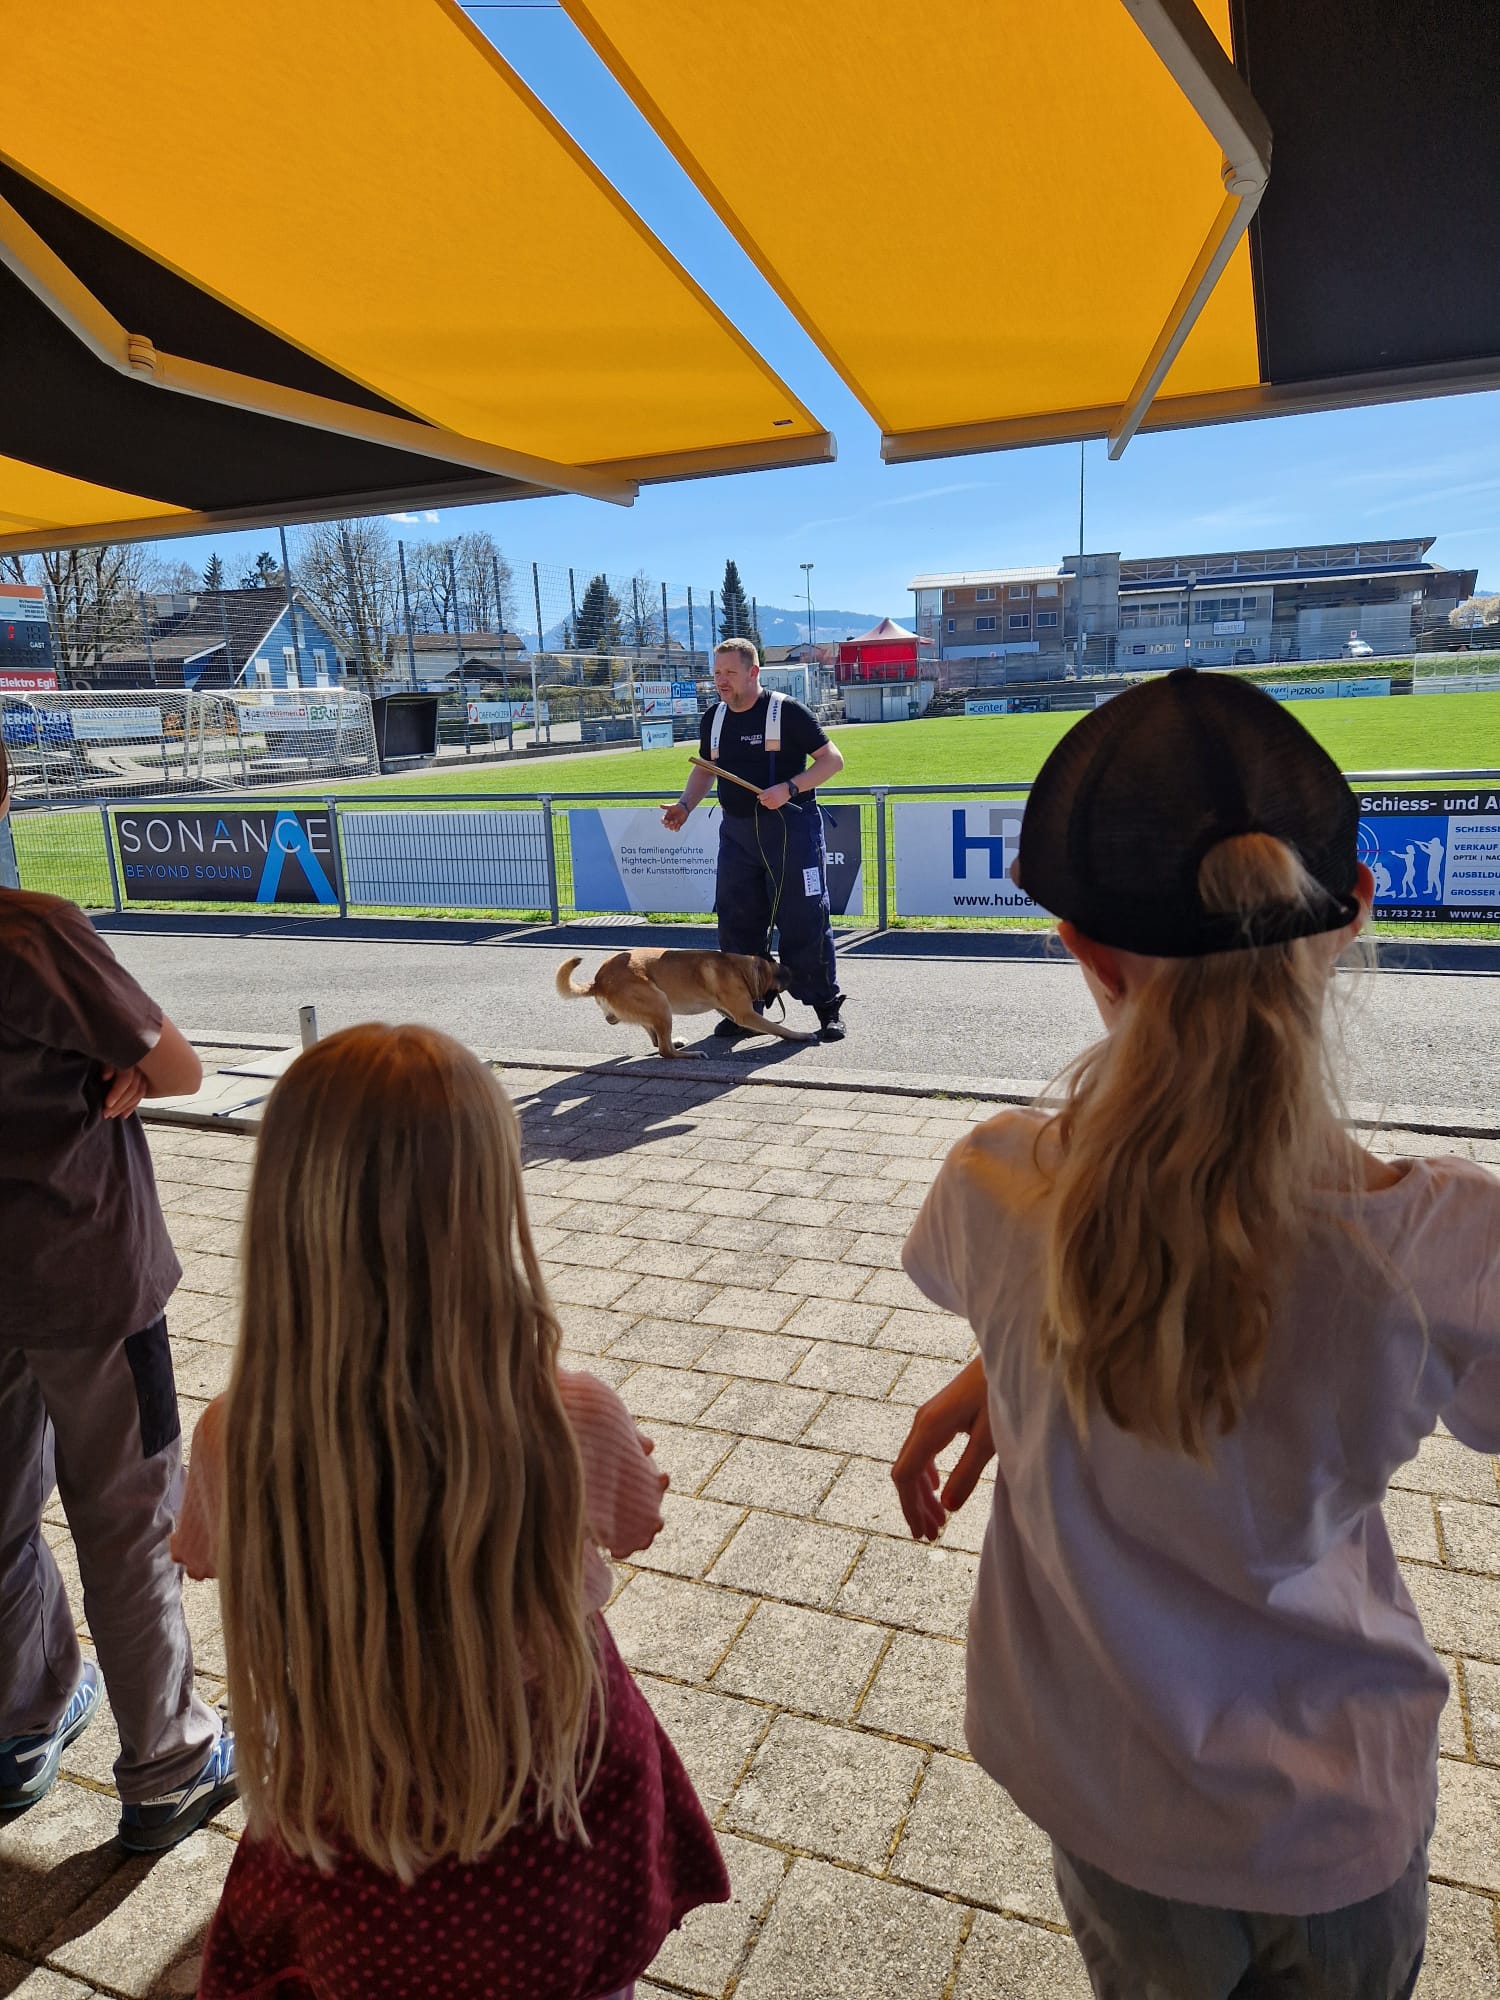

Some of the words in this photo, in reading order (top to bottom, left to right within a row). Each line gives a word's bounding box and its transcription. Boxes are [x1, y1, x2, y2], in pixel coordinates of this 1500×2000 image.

[30, 641, 45, 649] GAST
[0, 677, 35, 688] Elektro
[37, 678, 56, 690] Egli
[1290, 686, 1325, 696] PIZROG
[741, 734, 763, 742] POLIZEI
[1360, 796, 1438, 812] Schiess-
[1443, 795, 1479, 811] und
[1484, 796, 1500, 810] A
[121, 818, 331, 854] SONANCE
[620, 846, 637, 854] Das
[1454, 843, 1499, 851] VERKAUF
[621, 857, 715, 866] Hightech-Unternehmen
[126, 864, 189, 878] BEYOND
[195, 865, 252, 879] SOUND
[622, 867, 629, 875] in
[631, 867, 644, 875] der
[1451, 889, 1496, 897] GROSSER
[1376, 909, 1388, 917] 81
[1391, 909, 1408, 917] 733
[1410, 909, 1422, 918] 22
[1425, 910, 1436, 918] 11
